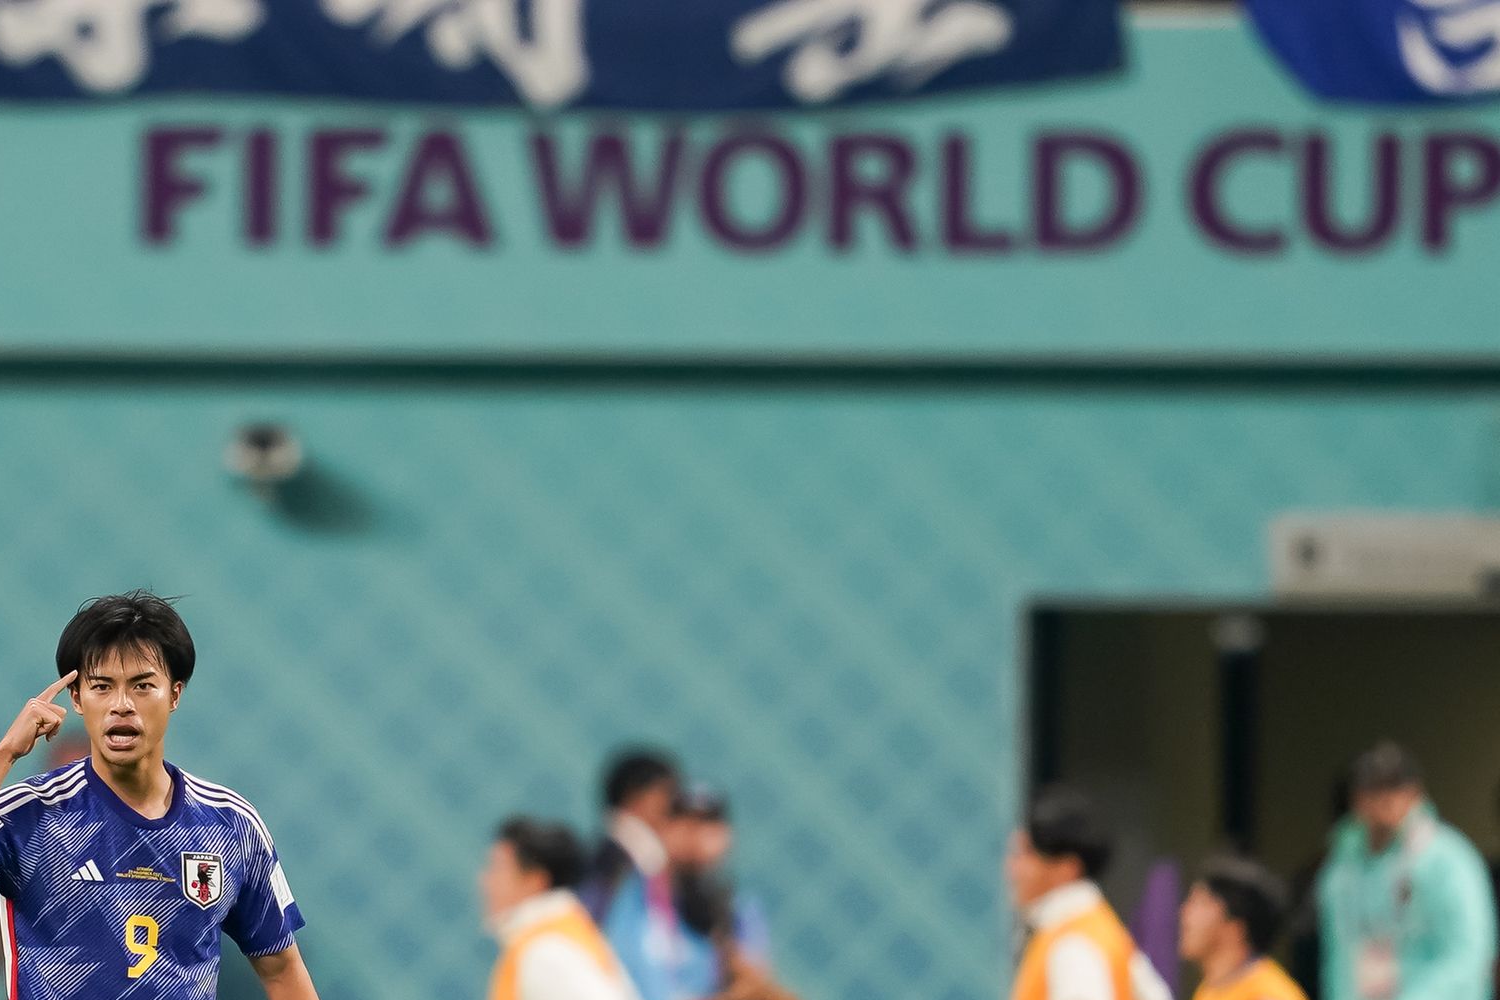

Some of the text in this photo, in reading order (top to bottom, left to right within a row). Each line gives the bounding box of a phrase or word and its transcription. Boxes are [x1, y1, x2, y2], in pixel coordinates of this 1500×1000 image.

[137, 124, 1500, 256] FIFA WORLD CUP
[125, 914, 159, 979] 9
